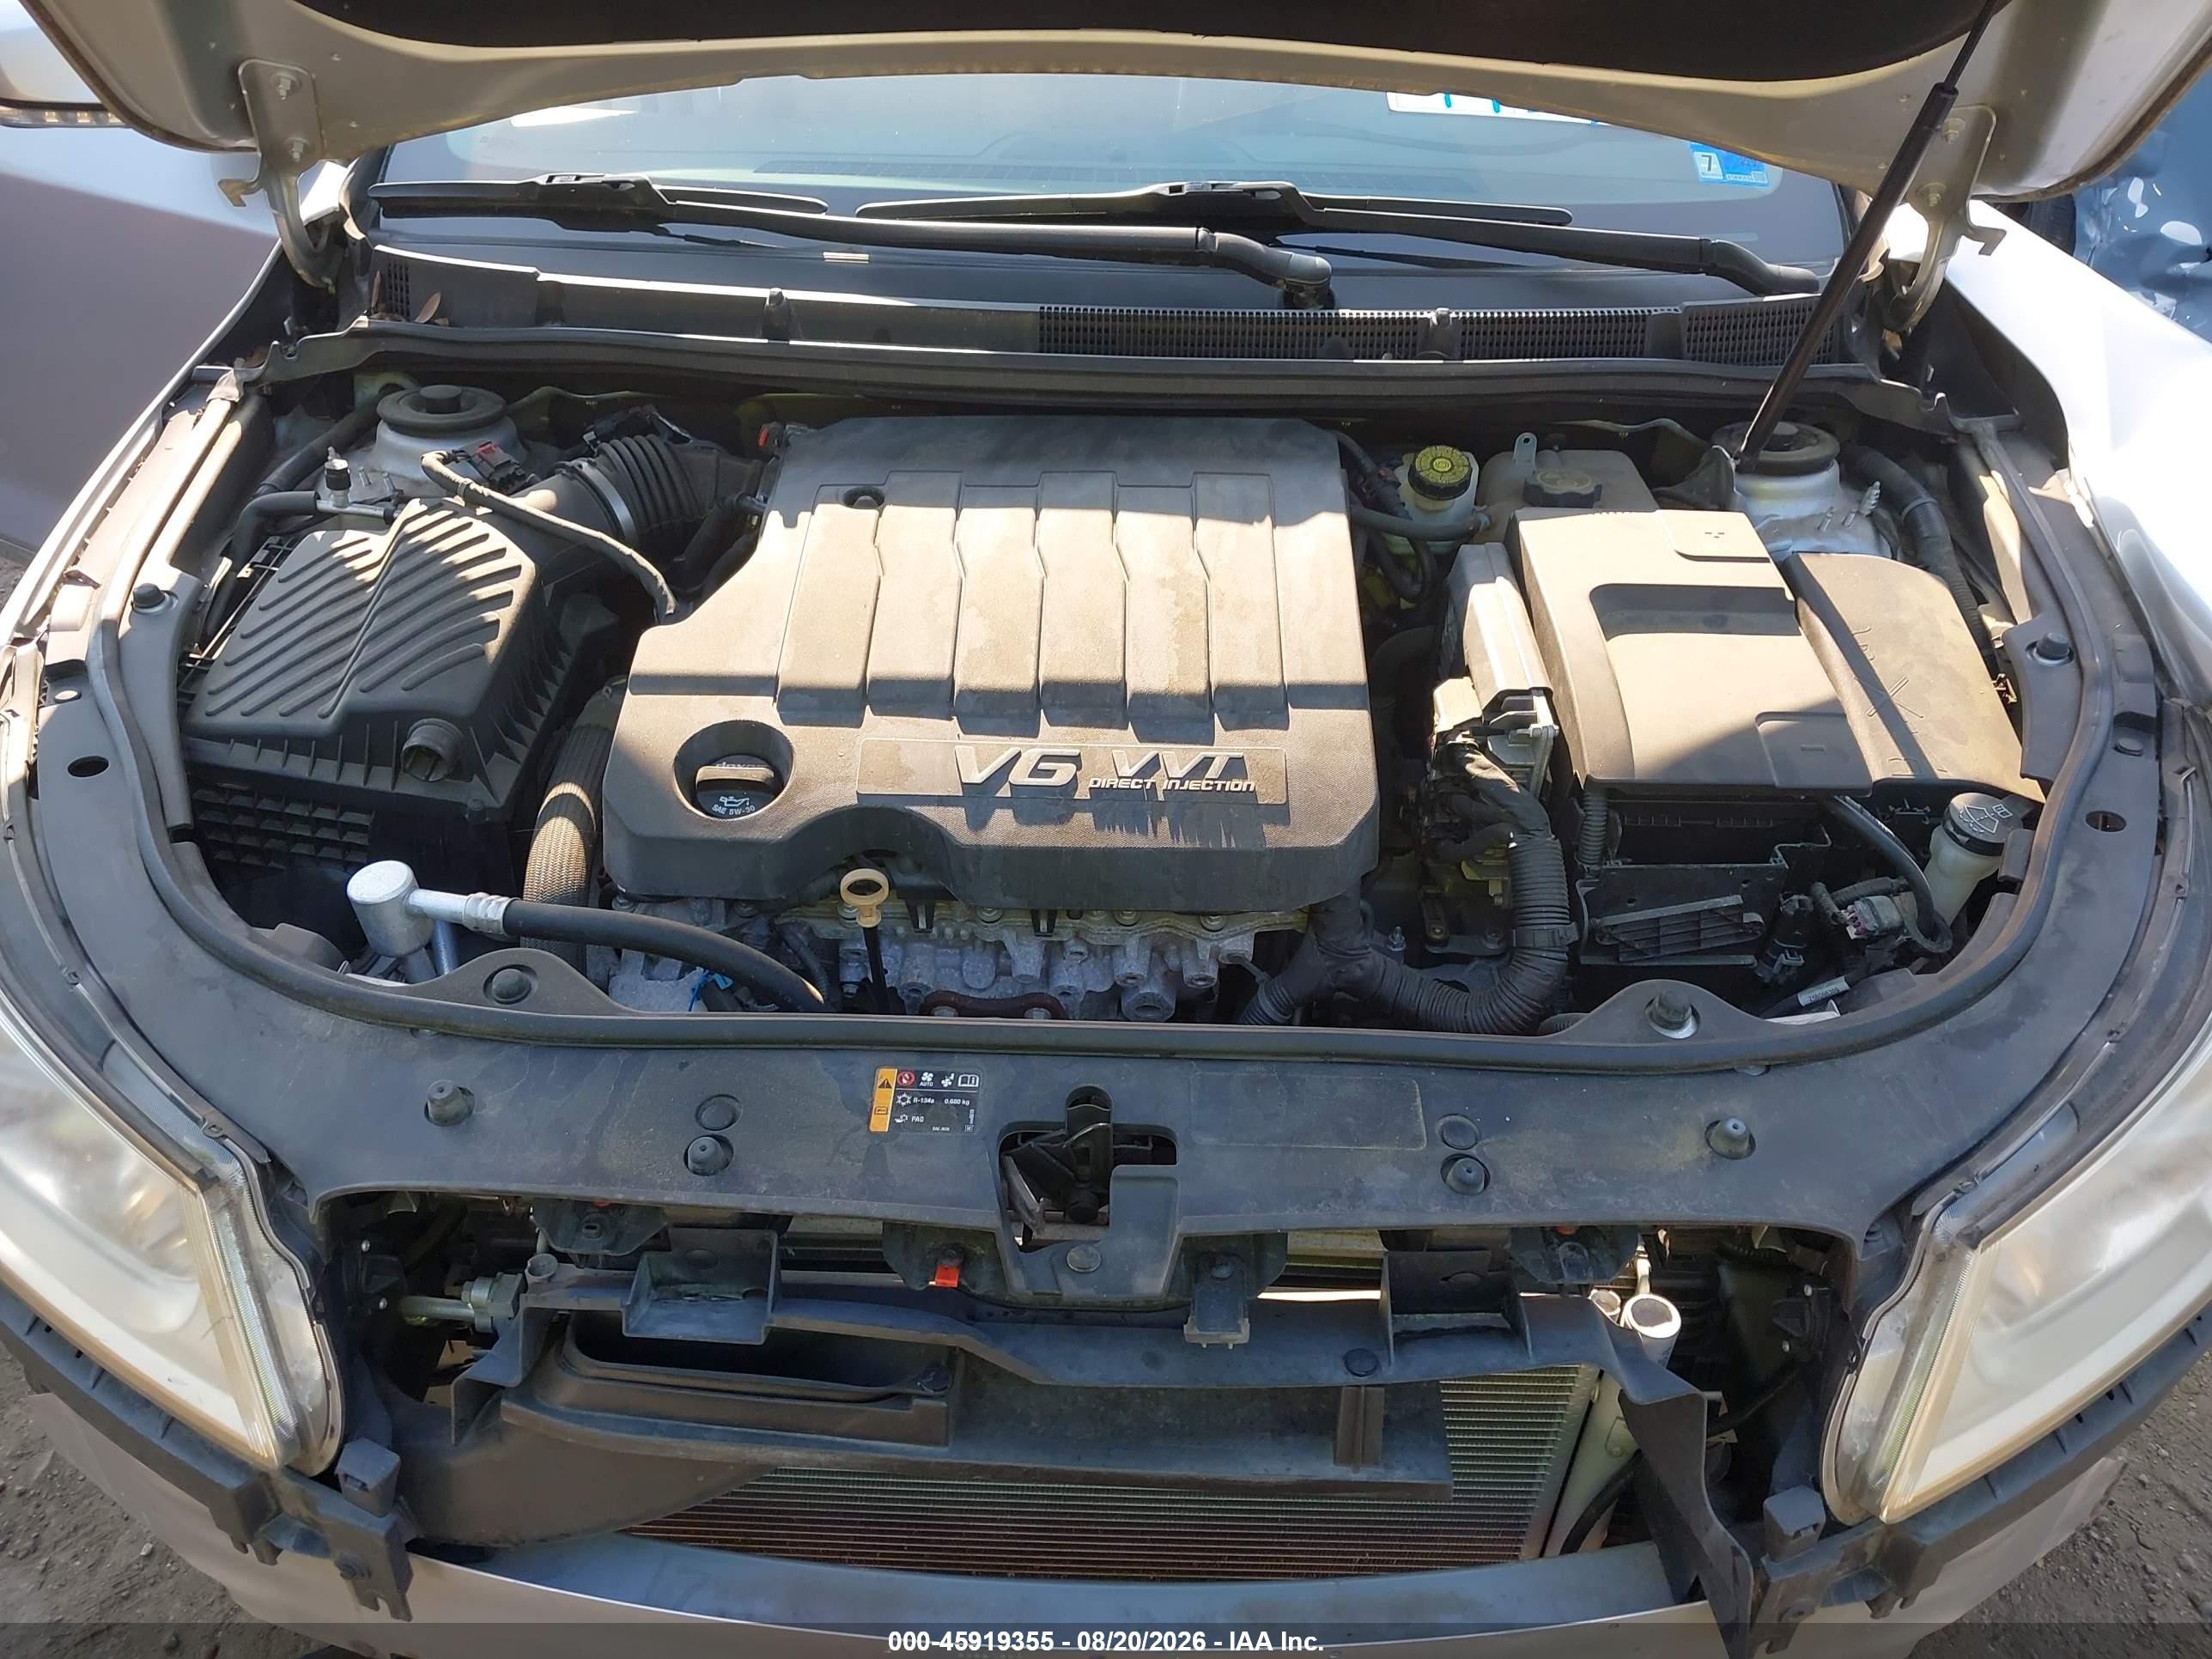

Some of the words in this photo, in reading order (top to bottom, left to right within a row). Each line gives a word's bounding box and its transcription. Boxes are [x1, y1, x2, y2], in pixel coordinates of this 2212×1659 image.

[1701, 155, 1712, 172] 7
[955, 744, 1080, 786] V6
[1111, 750, 1244, 779] VVT
[1089, 778, 1156, 790] DIRECT
[1163, 780, 1255, 792] INJECTION
[712, 804, 726, 814] SAE
[729, 805, 756, 815] 5W-30
